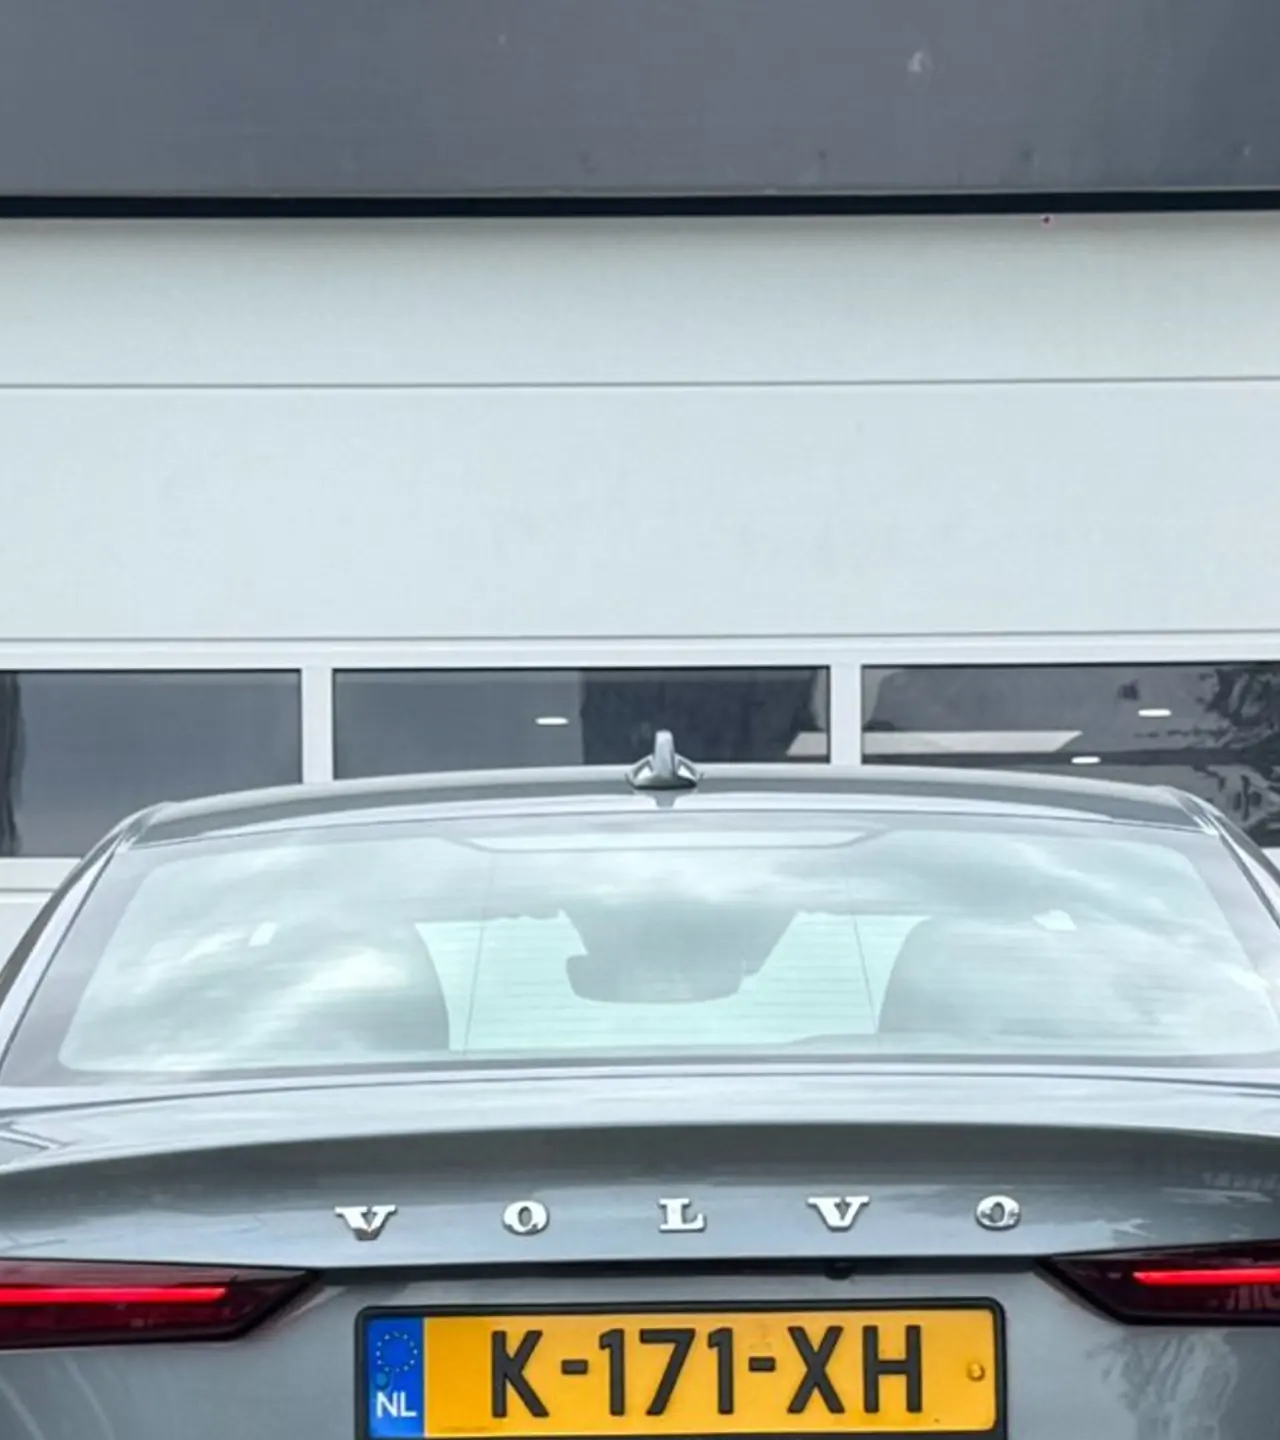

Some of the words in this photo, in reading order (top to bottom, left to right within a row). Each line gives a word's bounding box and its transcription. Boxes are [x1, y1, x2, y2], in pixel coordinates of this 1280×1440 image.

[335, 1194, 1021, 1240] VOLVO
[490, 1324, 923, 1418] K-171-XH
[376, 1389, 418, 1418] NL
